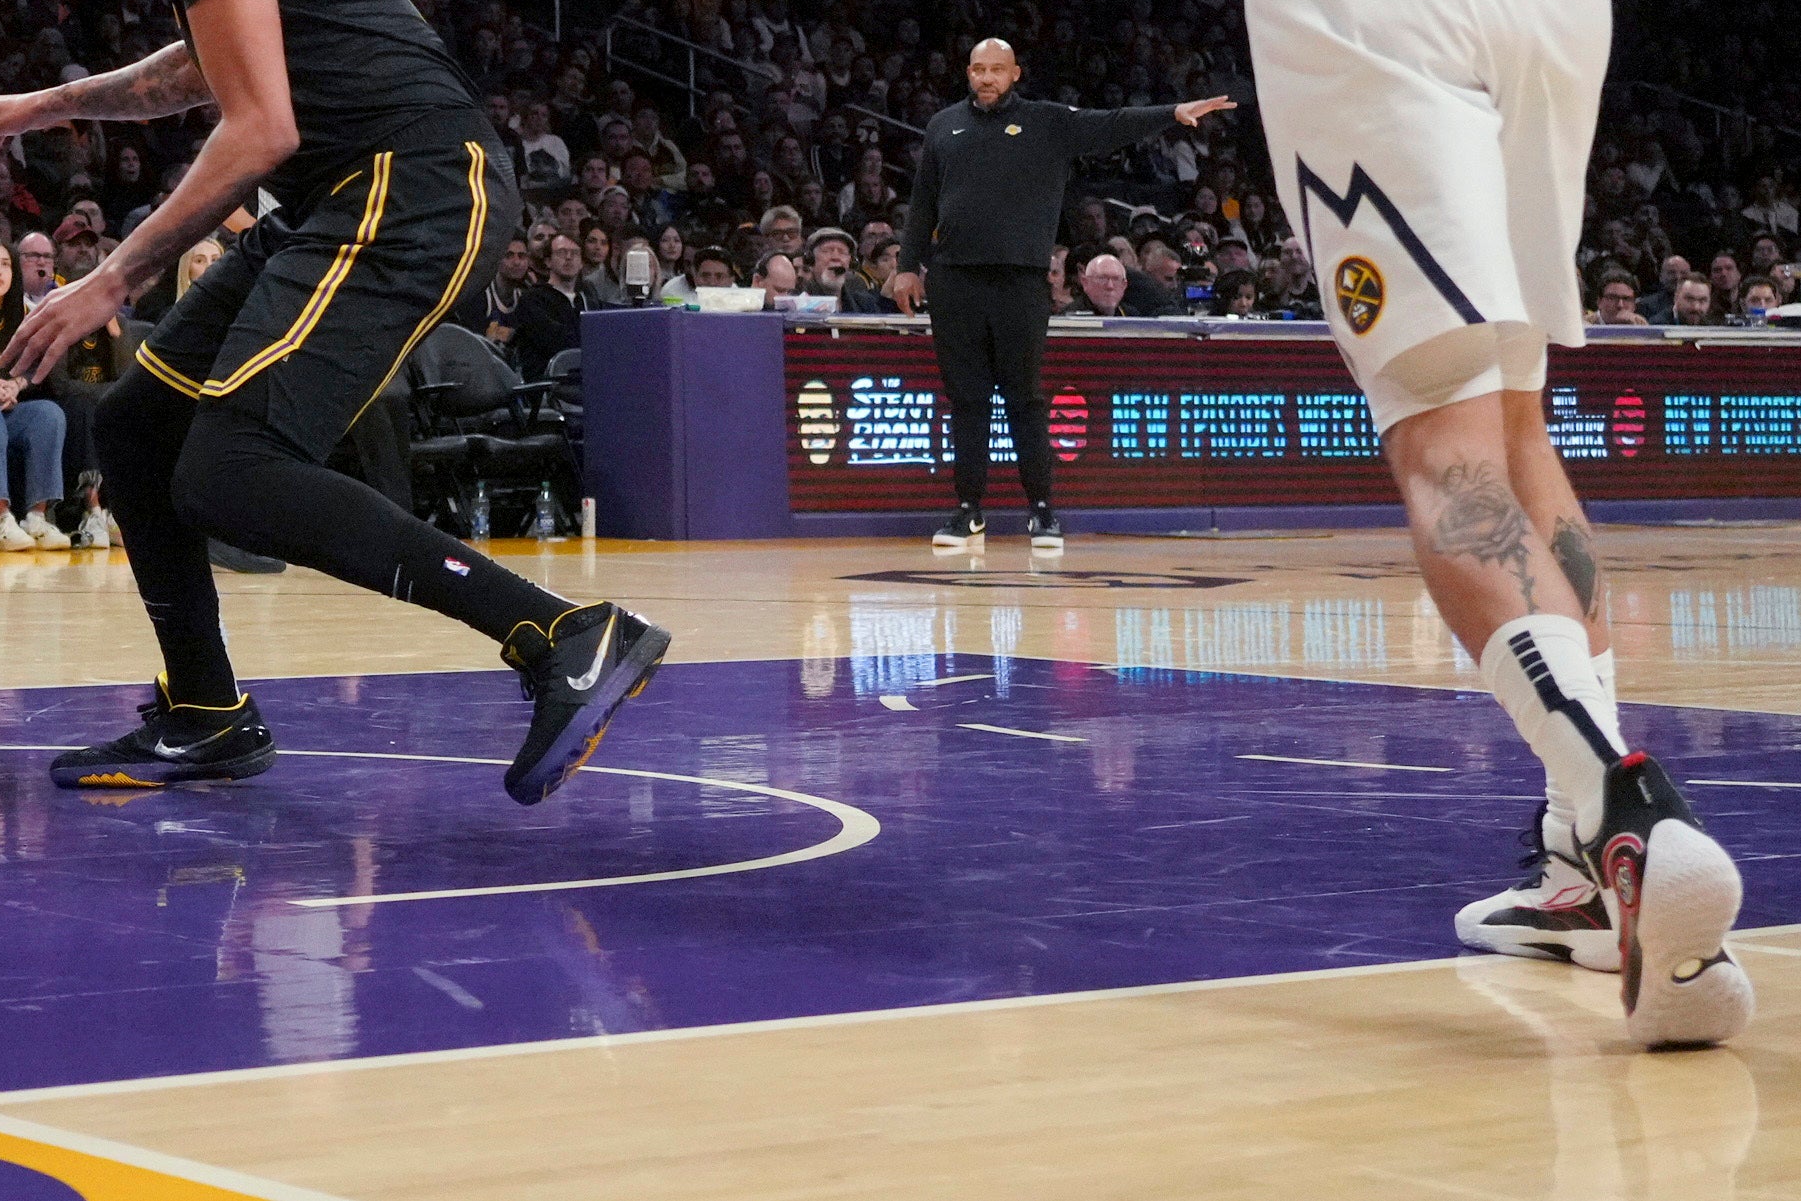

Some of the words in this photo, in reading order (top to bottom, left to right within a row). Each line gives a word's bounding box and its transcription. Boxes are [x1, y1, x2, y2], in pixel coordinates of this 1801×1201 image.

[1112, 394, 1168, 458] NEW
[1180, 394, 1287, 458] EPISODES
[1664, 396, 1712, 455] NEW
